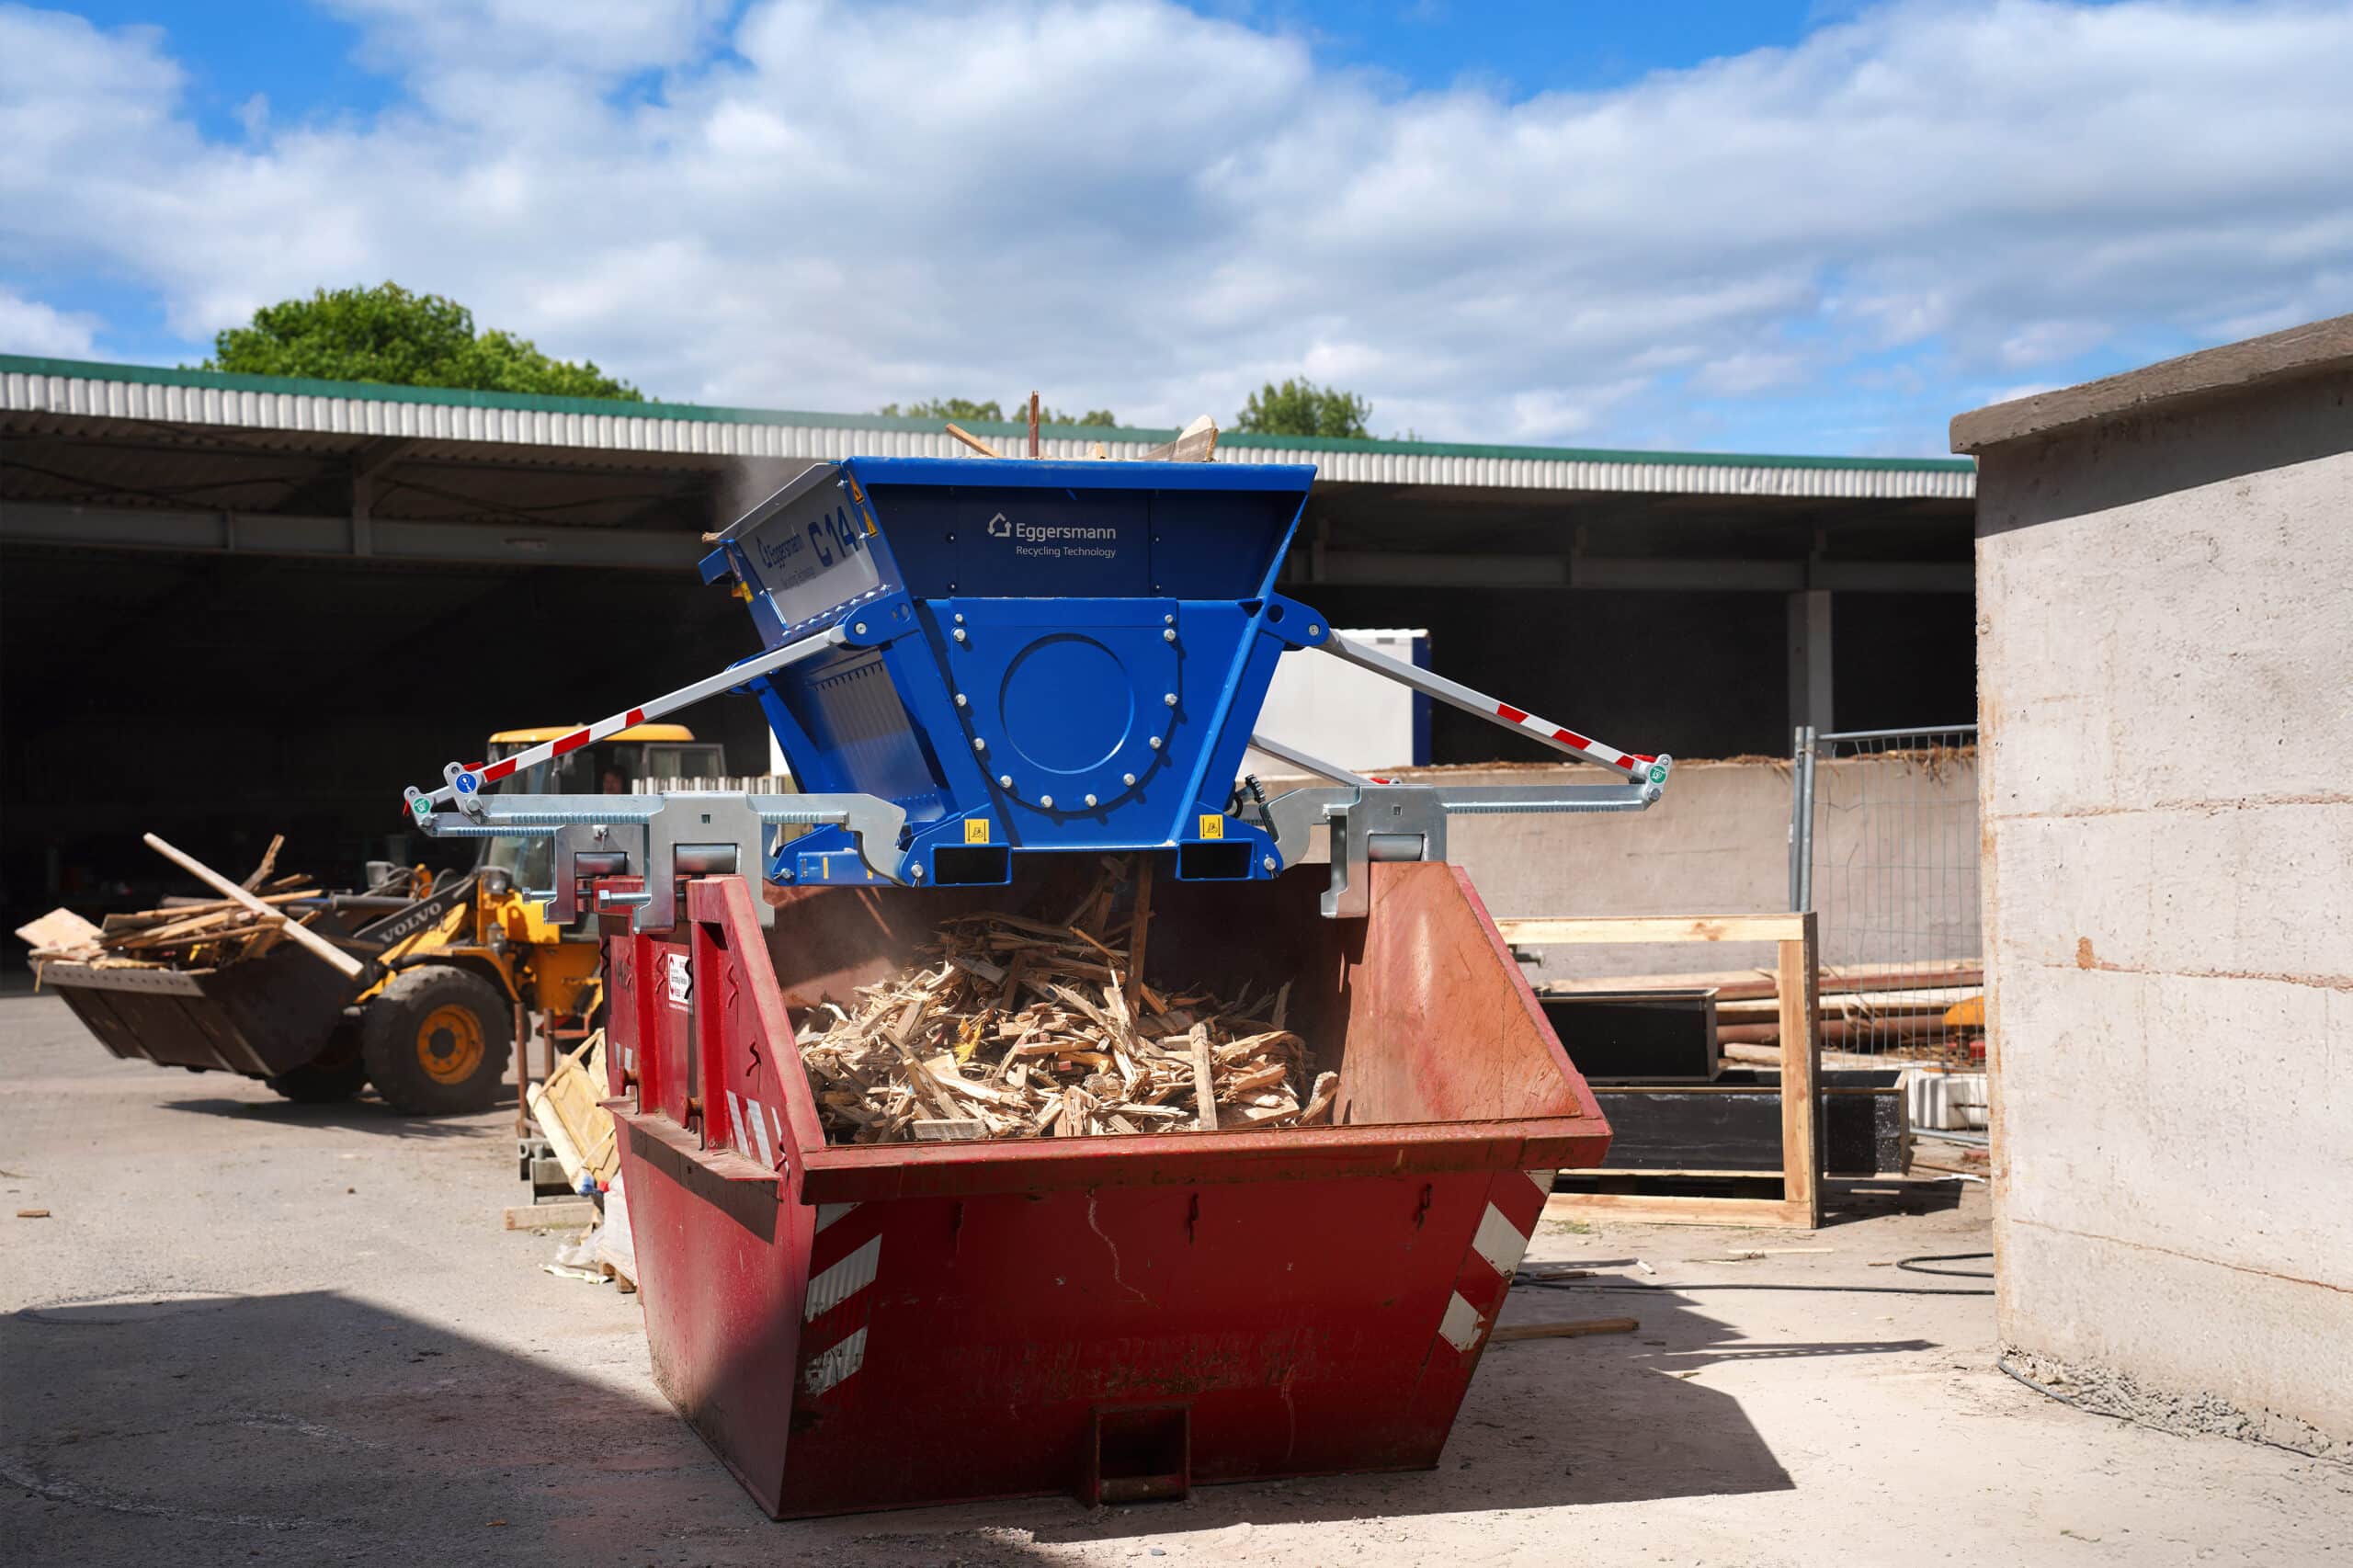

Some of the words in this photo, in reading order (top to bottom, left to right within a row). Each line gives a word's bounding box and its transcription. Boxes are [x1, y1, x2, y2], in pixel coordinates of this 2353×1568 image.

[808, 506, 859, 567] C14
[1017, 523, 1116, 541] Eggersmann
[1017, 546, 1061, 557] Recycling
[1063, 547, 1116, 558] Technology
[379, 903, 441, 942] VOLVO
